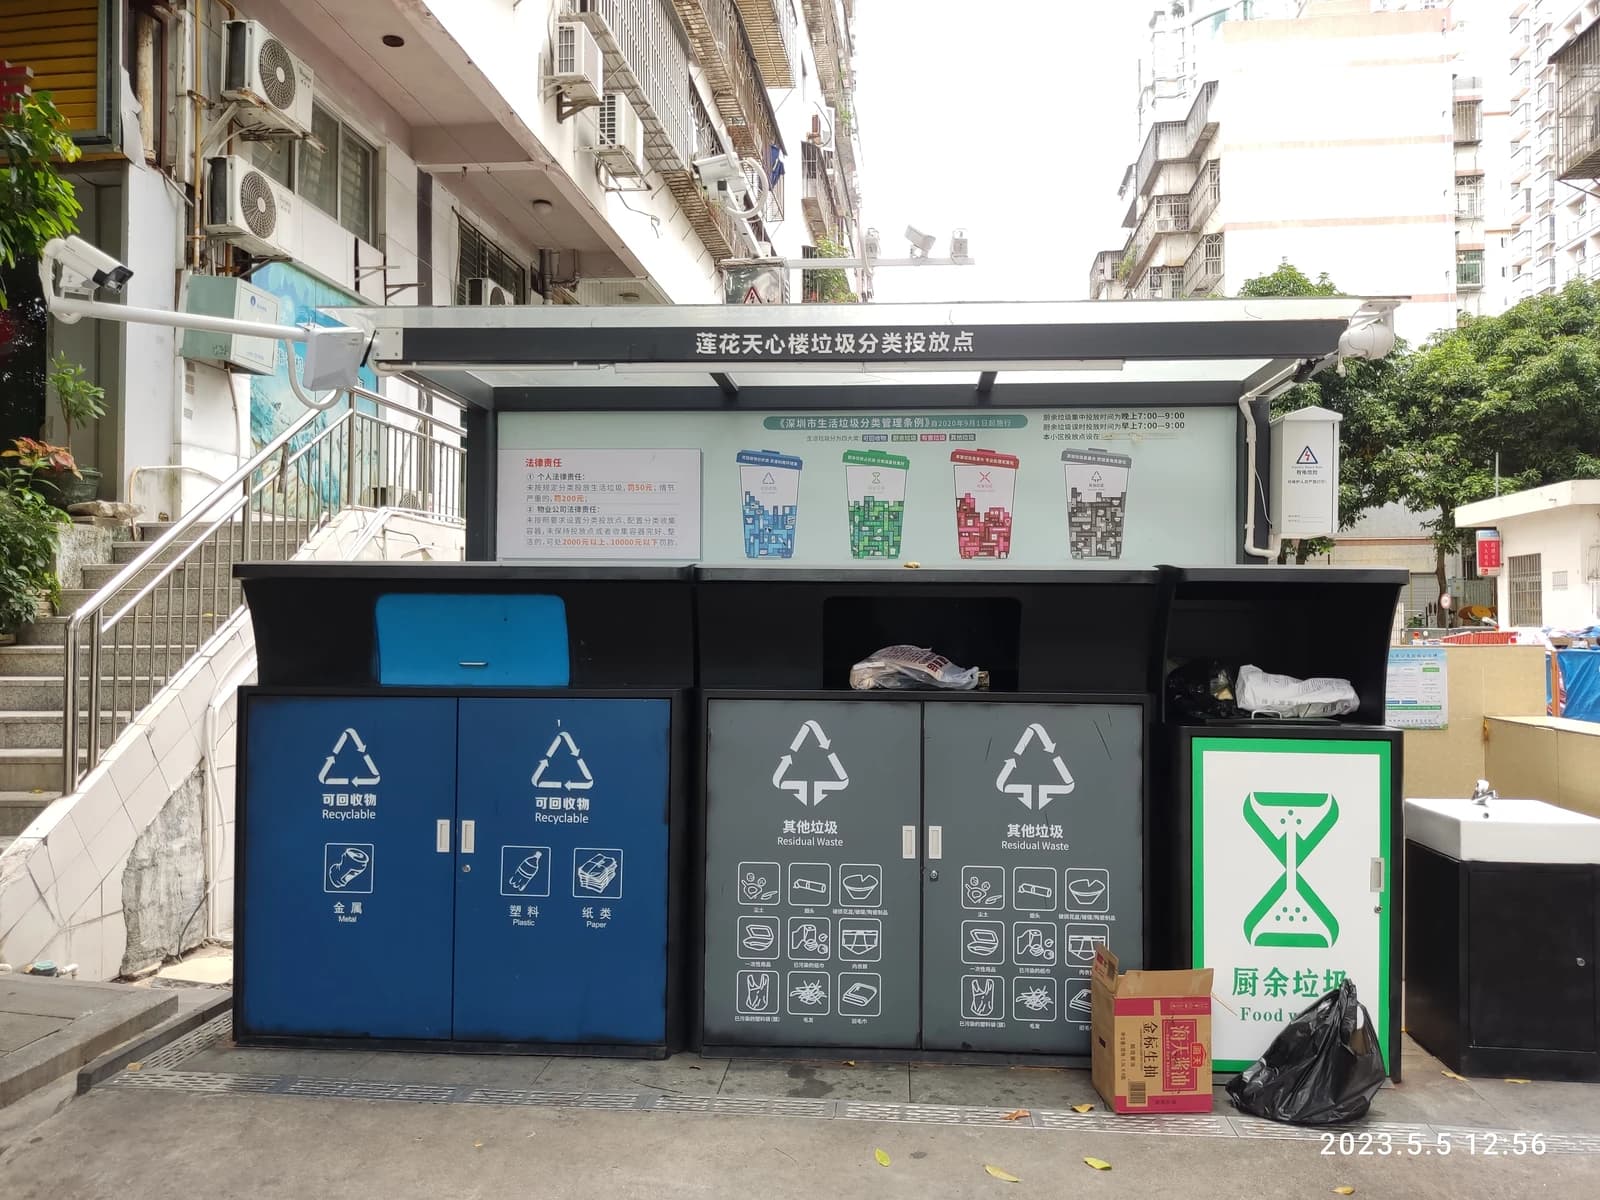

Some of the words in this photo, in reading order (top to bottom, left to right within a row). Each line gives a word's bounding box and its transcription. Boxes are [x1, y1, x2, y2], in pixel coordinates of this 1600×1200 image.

[696, 331, 974, 354] 莲花天心楼垃圾分类投放点
[525, 458, 562, 468] 法律责任
[322, 793, 377, 807] 可回收物
[535, 797, 590, 811] 可回收物
[322, 808, 376, 821] Recyclable
[535, 812, 589, 825] Recyclable
[783, 819, 838, 835] 其他垃圾
[1007, 824, 1064, 839] 其他垃圾
[777, 836, 815, 847] Residual
[817, 837, 844, 847] Waste
[1001, 840, 1040, 850] Residual
[1042, 841, 1070, 851] Waste
[333, 902, 362, 914] 金属
[509, 905, 540, 918] 塑料
[582, 907, 612, 920] 纸类
[338, 915, 357, 924] Metal
[512, 918, 536, 927] Plastic
[586, 920, 607, 930] Paper
[1232, 967, 1348, 998] 厨余垃圾
[1240, 1007, 1283, 1023] Food
[1143, 1022, 1159, 1078] 金标生抽
[1170, 1025, 1191, 1086] 海天酱油
